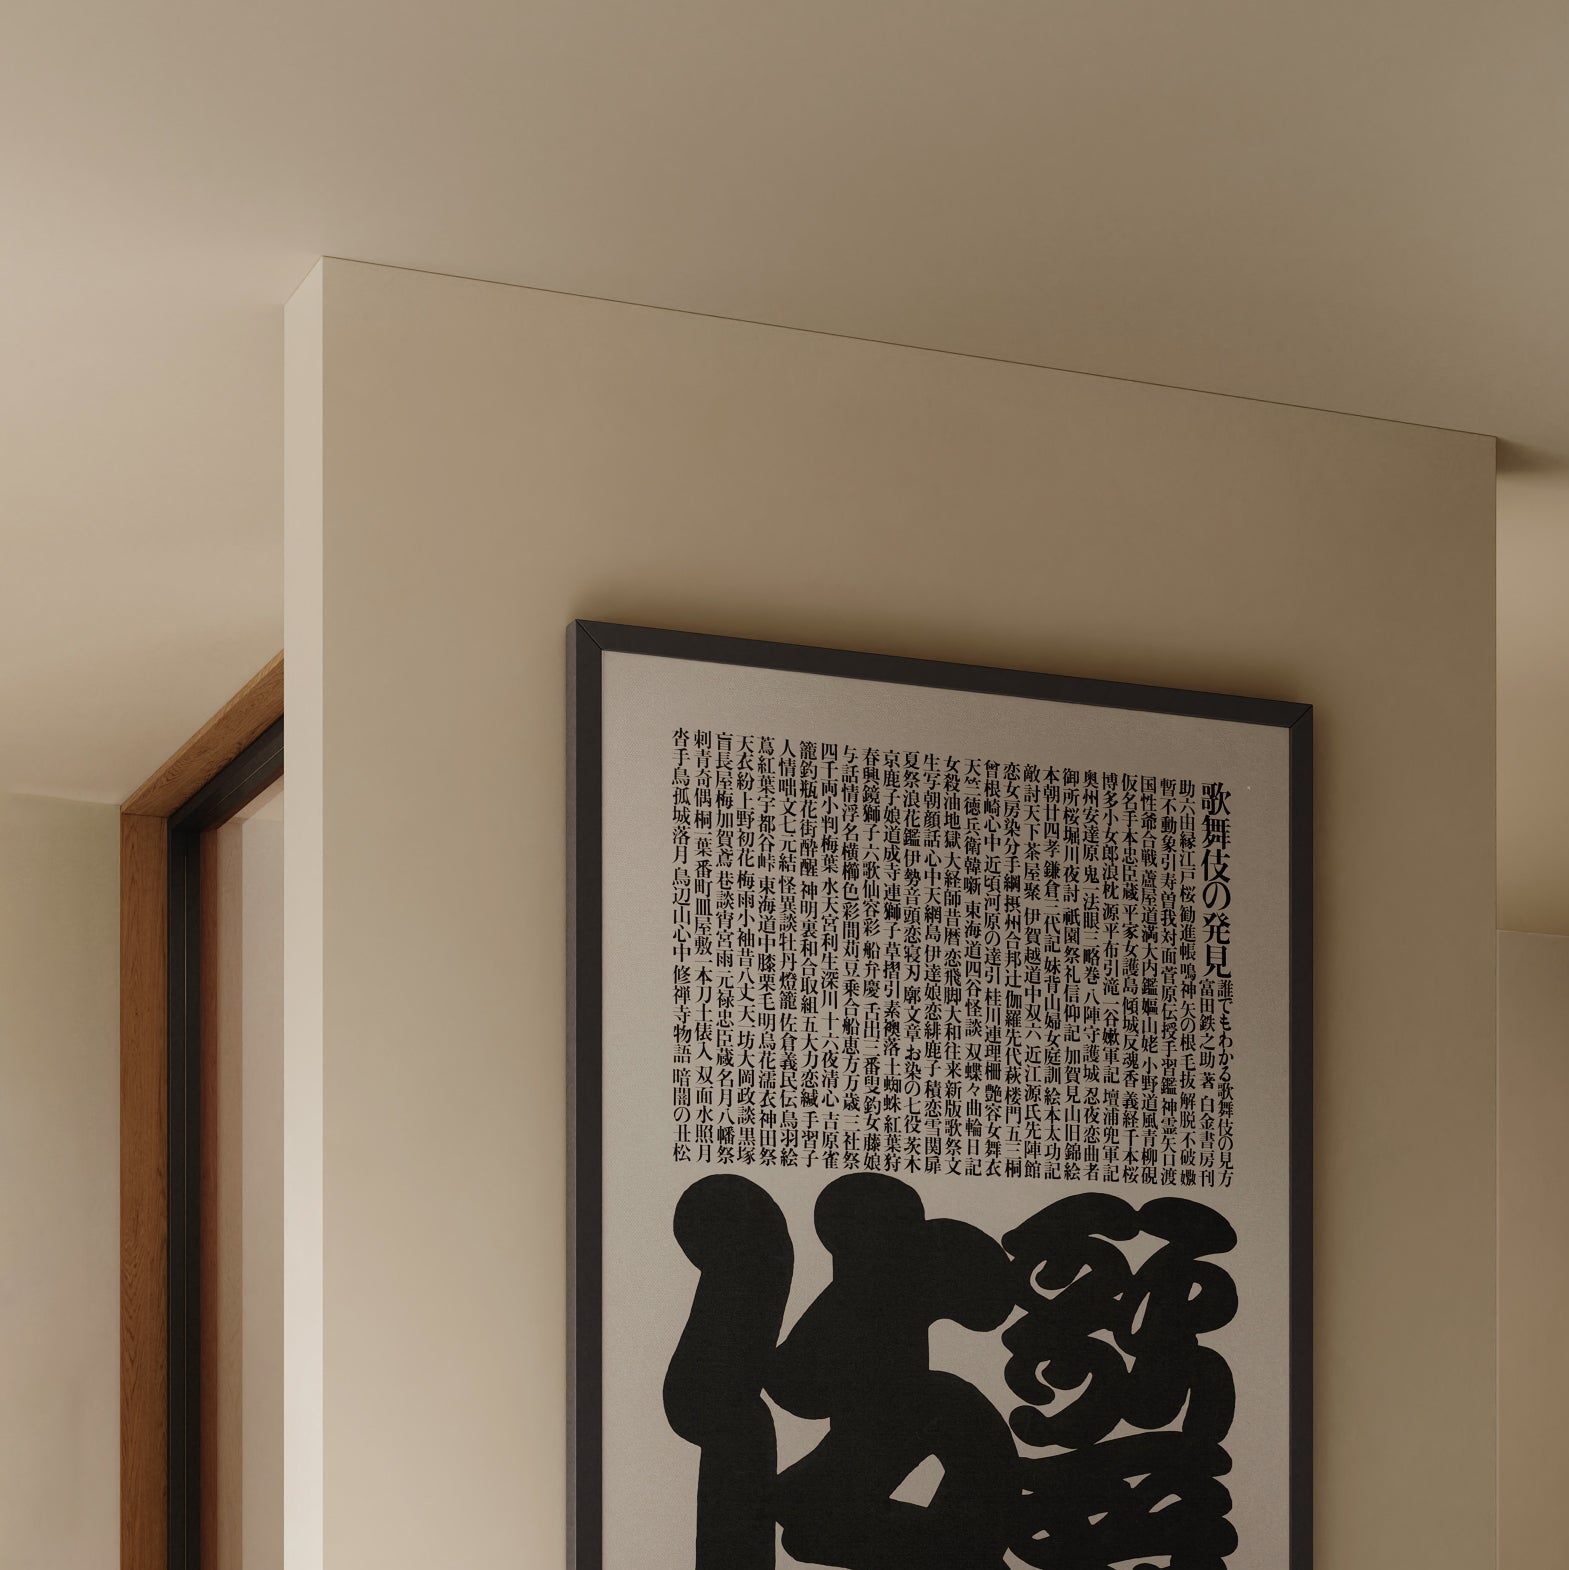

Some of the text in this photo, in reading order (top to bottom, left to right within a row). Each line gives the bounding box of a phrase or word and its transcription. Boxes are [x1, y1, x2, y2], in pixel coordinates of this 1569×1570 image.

[1201, 783, 1232, 978] 歌舞伎の発見
[1217, 979, 1234, 1188] 誰でもわかる歌舞伎の見方
